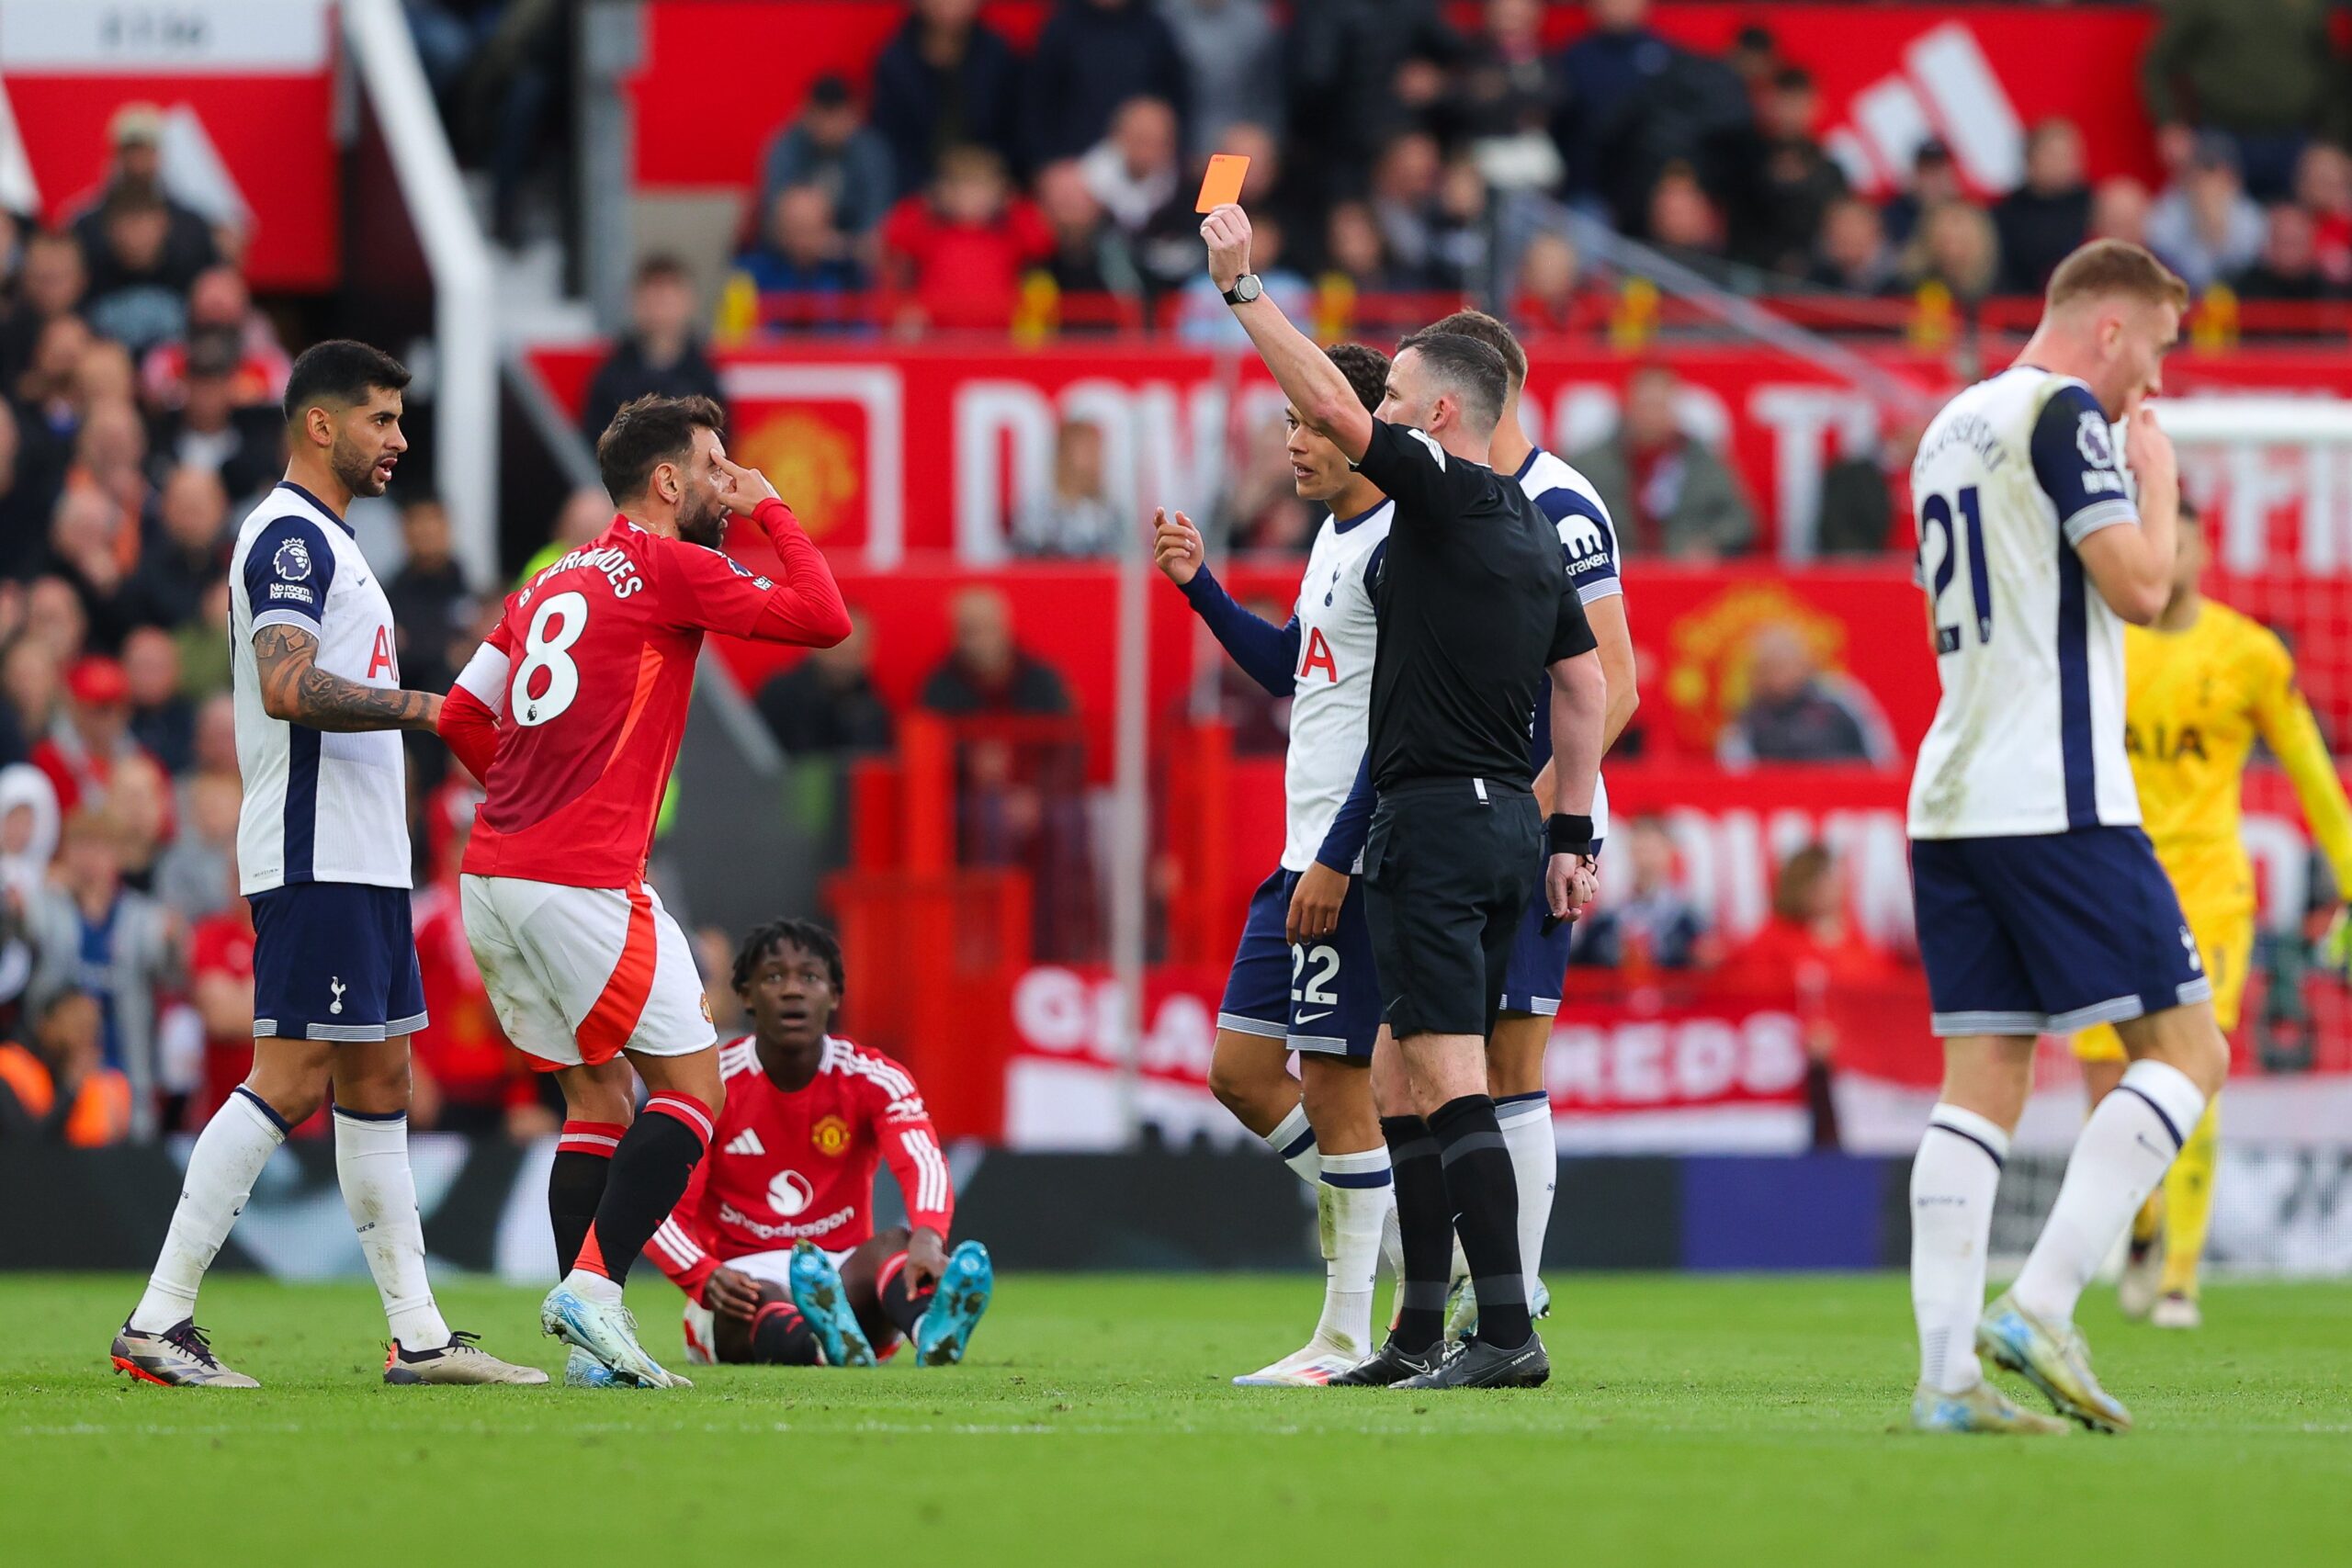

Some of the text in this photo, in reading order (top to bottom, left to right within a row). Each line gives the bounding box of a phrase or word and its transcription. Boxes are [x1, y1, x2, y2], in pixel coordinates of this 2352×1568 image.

[269, 582, 311, 595] No room
[536, 546, 643, 599] FERNANDES
[1918, 485, 1992, 655] 21
[511, 591, 589, 728] 8
[1291, 942, 1340, 1005] 22
